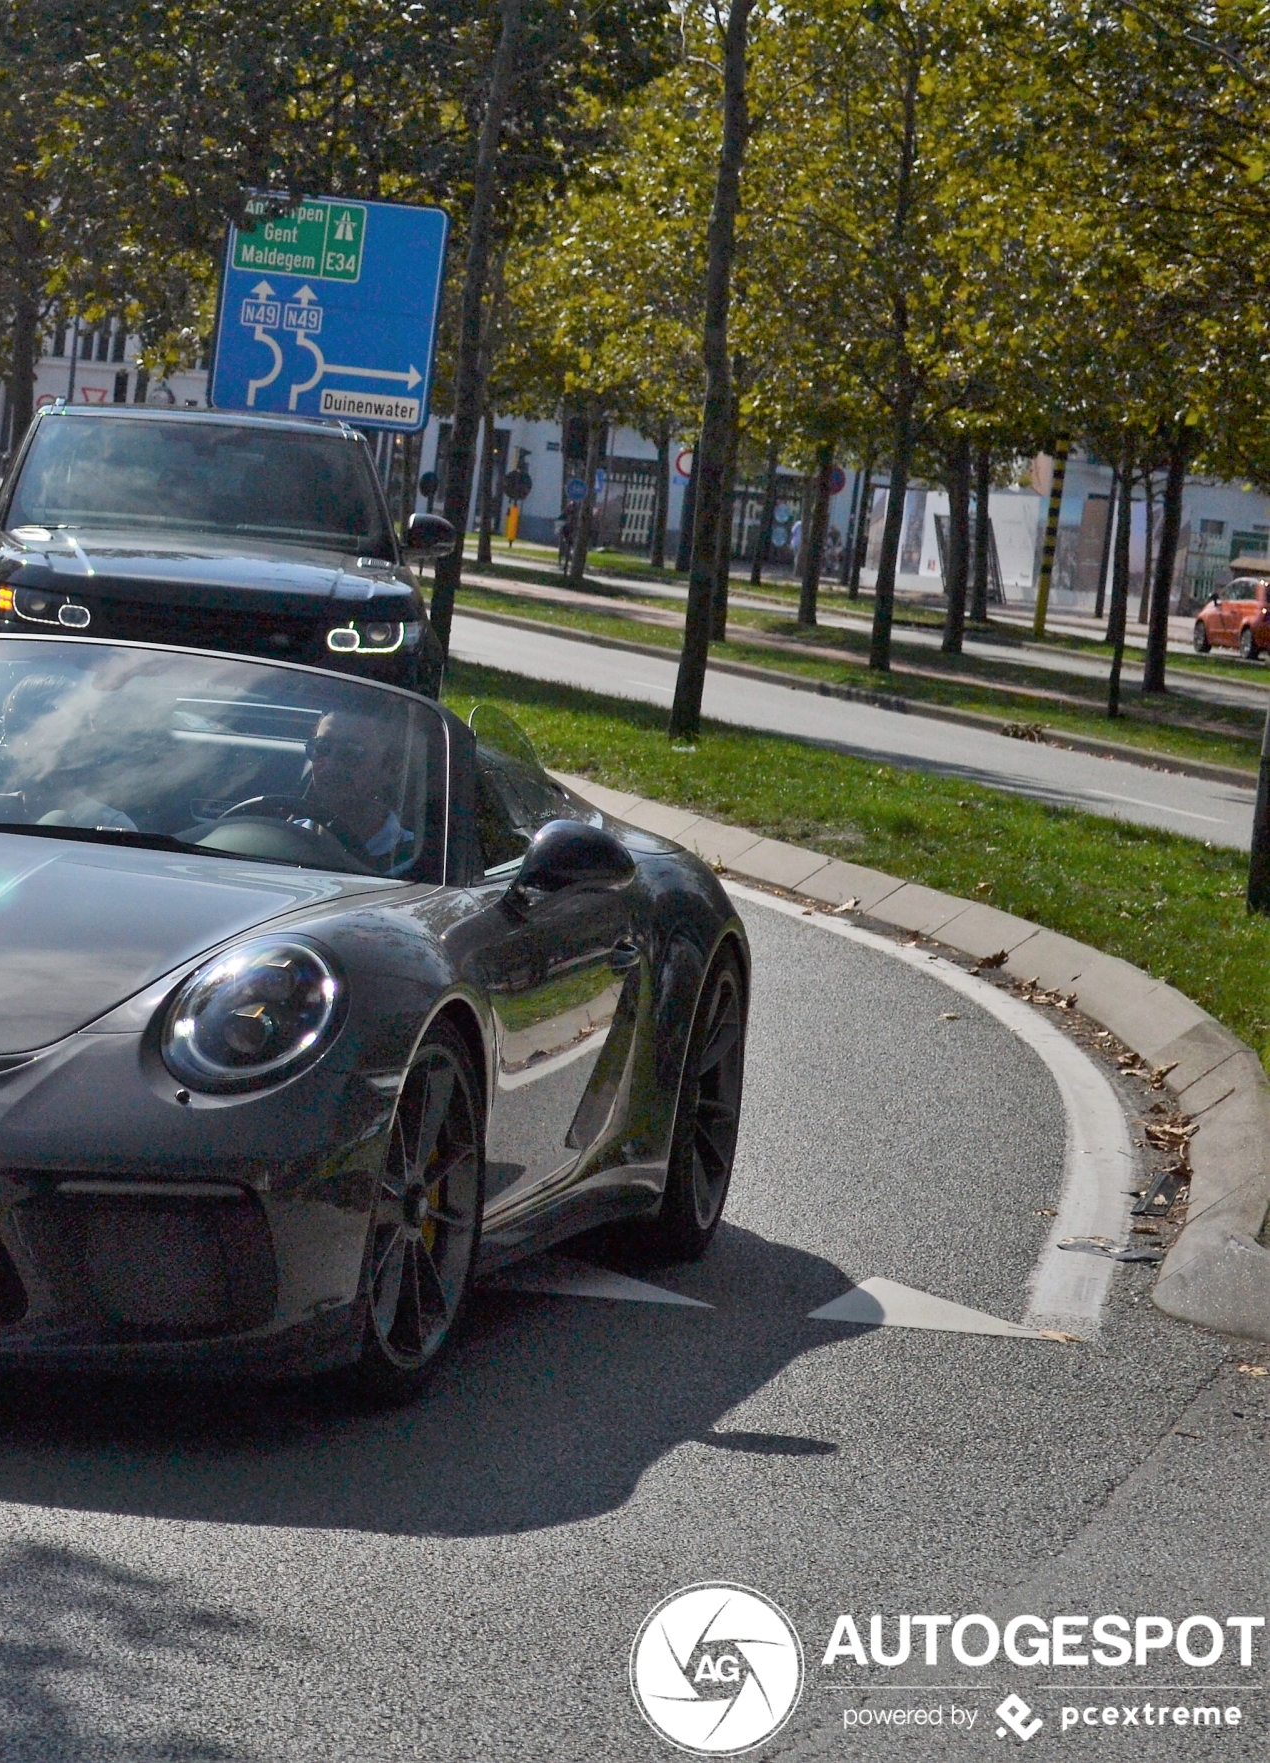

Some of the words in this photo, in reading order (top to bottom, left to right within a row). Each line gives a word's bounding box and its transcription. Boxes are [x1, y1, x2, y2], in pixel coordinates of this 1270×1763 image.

[264, 223, 299, 243] Gent
[241, 244, 316, 272] Maldegem
[325, 252, 357, 273] E34
[243, 306, 276, 324] N49
[287, 311, 320, 329] N49
[323, 393, 416, 419] Duinenwater
